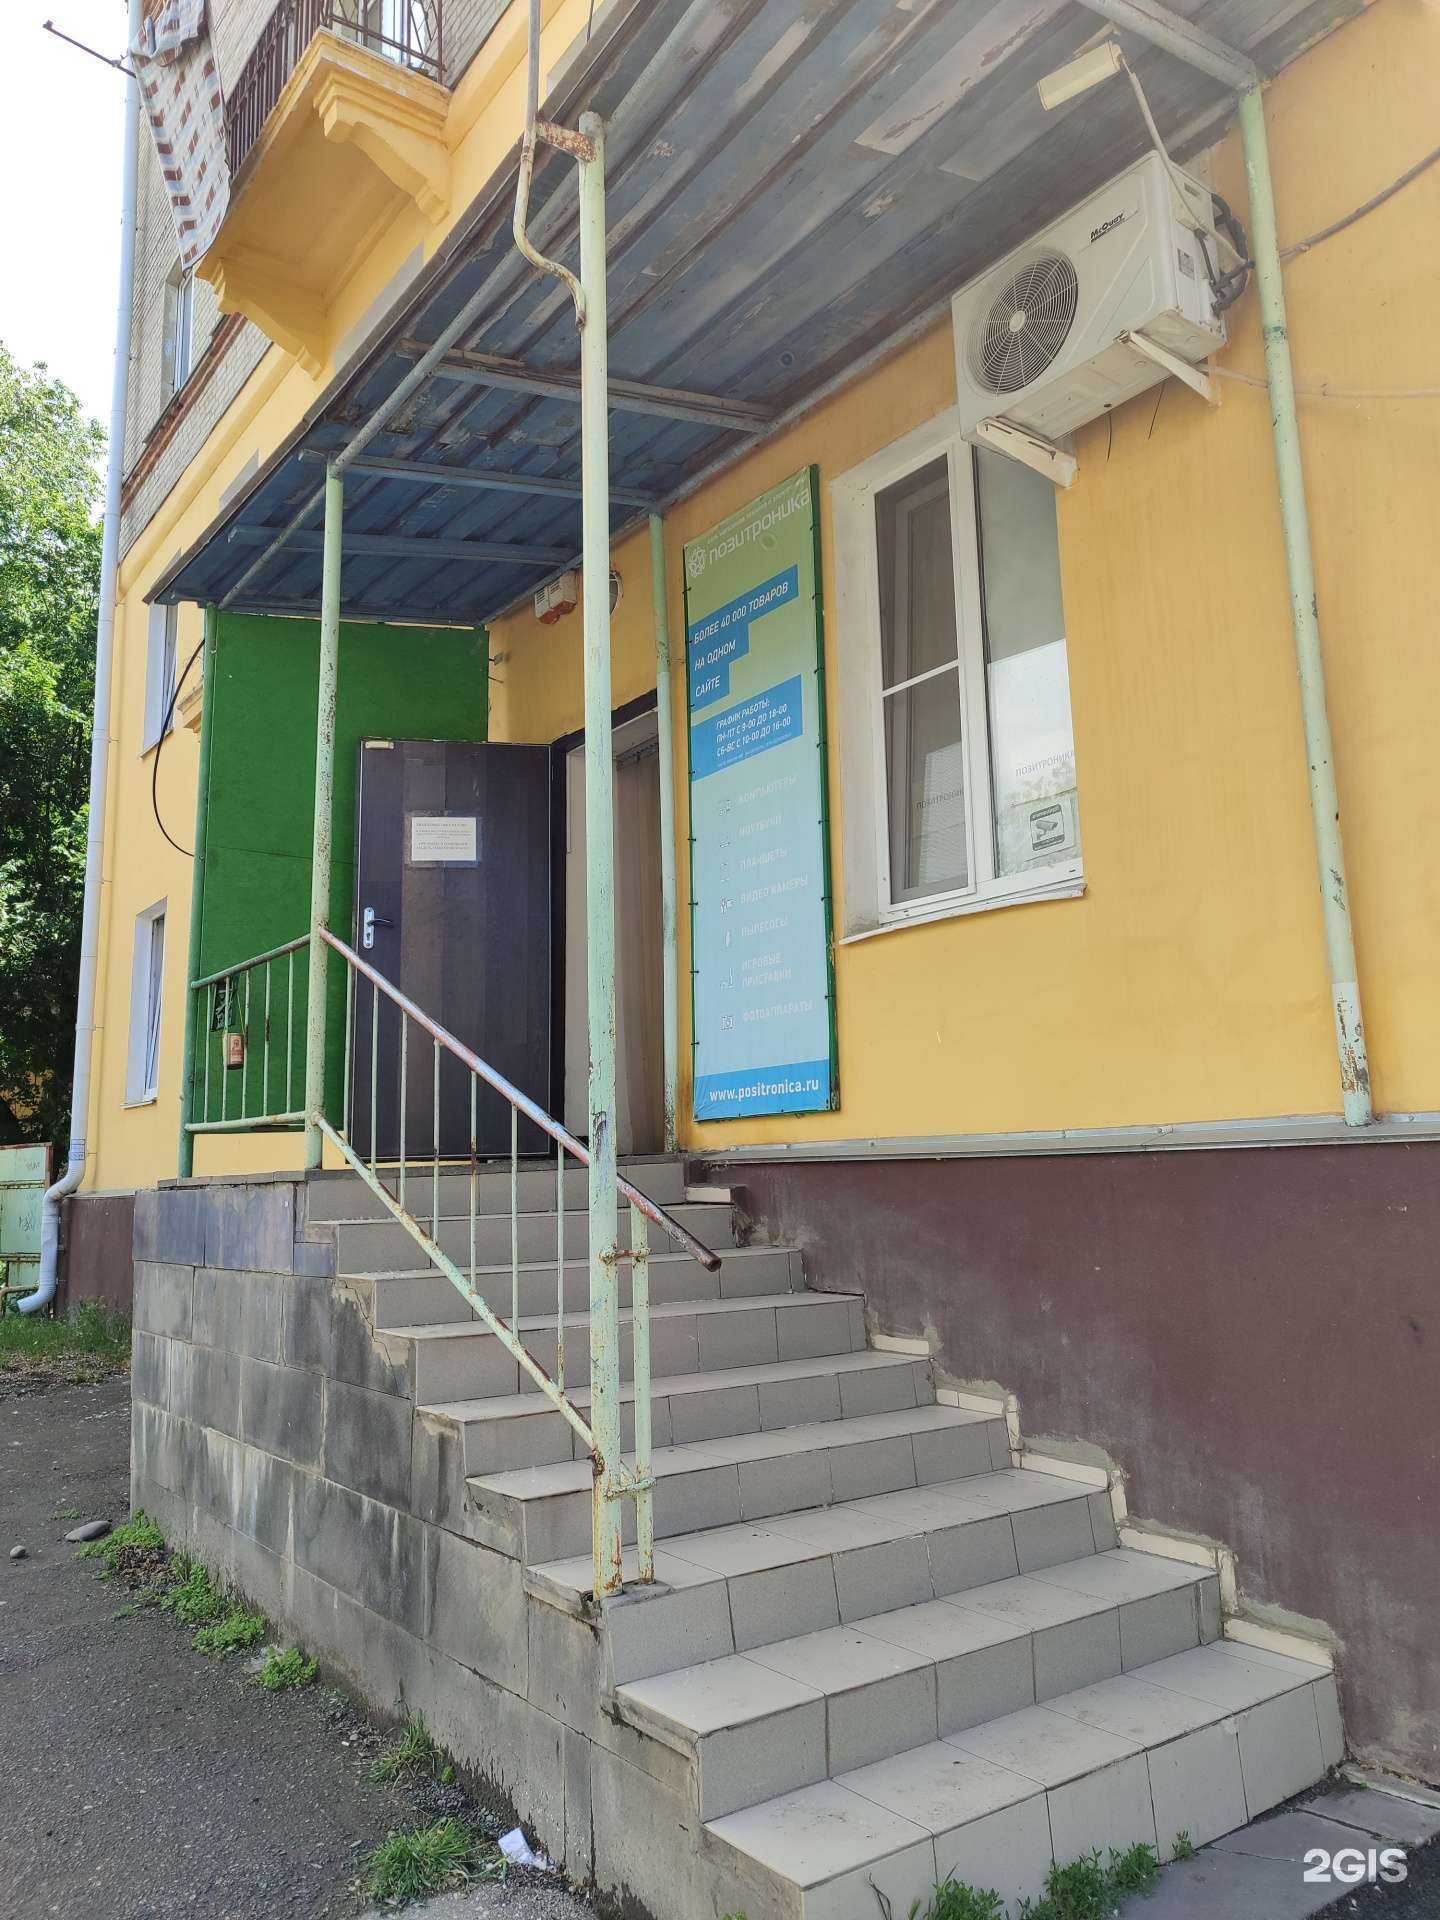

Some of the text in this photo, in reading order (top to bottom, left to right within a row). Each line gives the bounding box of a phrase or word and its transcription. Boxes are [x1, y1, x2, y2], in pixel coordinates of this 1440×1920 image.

[1090, 213, 1125, 240] McQuay
[694, 581, 789, 645] БОЛЕЕ 40 000 ТОВАРОВ
[694, 639, 736, 671] НА ОДНОМ
[695, 675, 721, 697] САЙТЕ
[716, 711, 741, 730] ГРАФИК
[716, 727, 736, 744] ПН-ПТ
[756, 712, 767, 727] ДО
[716, 741, 736, 757] СБ-ВС
[760, 724, 771, 739] ДО
[709, 1079, 819, 1101] www.positronica.ru
